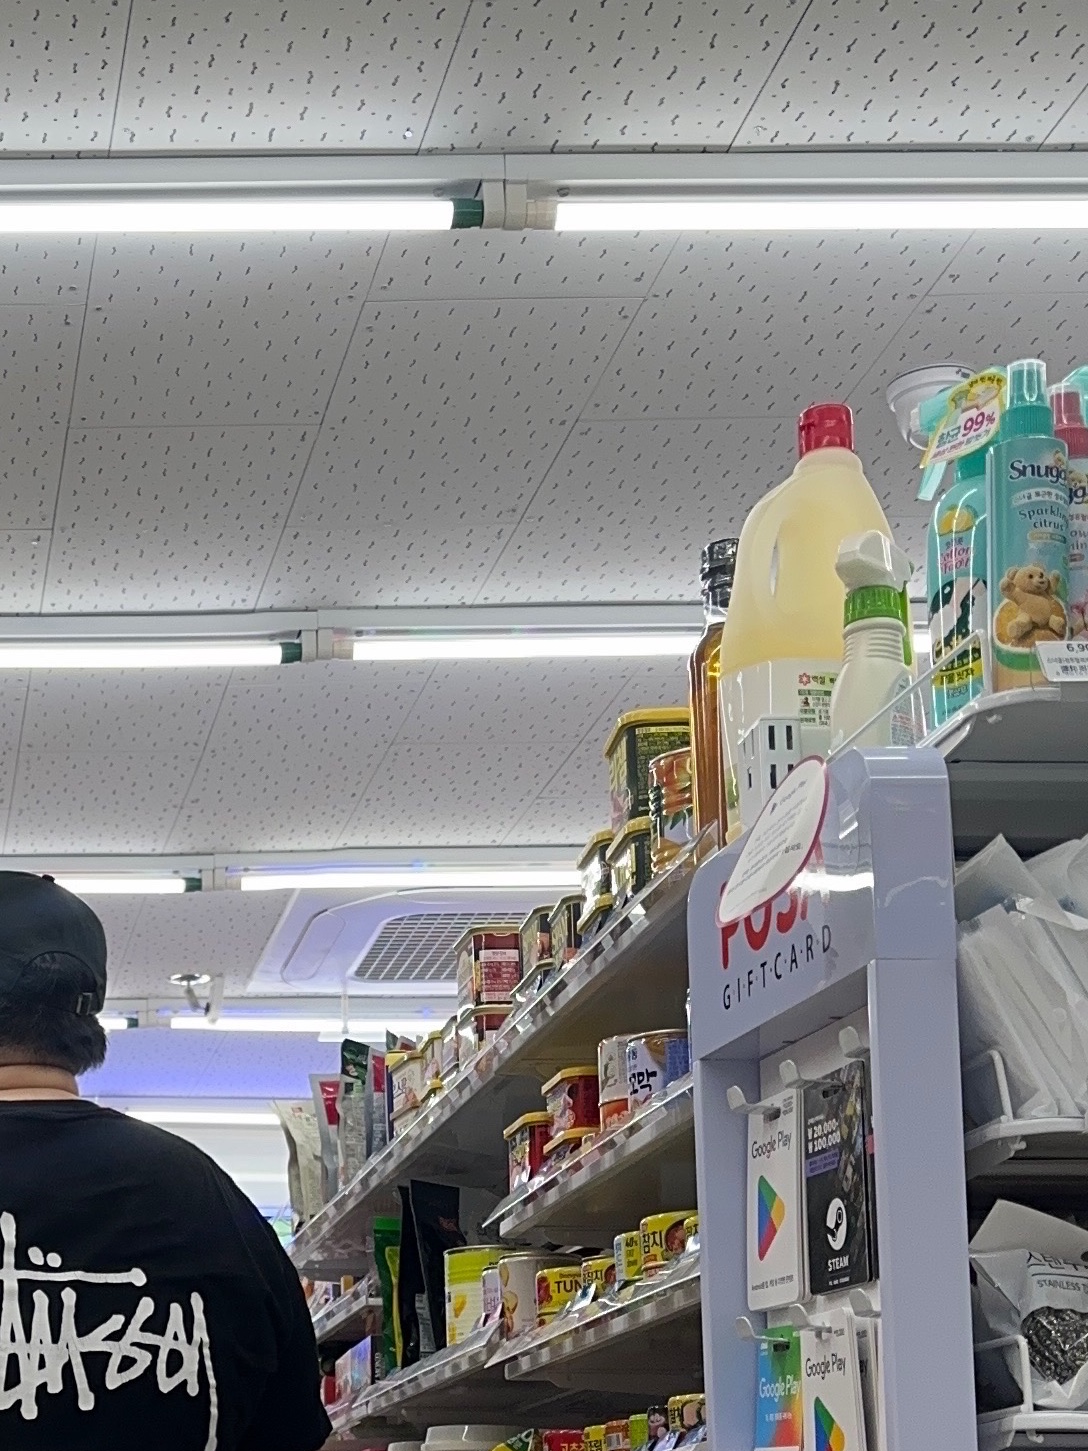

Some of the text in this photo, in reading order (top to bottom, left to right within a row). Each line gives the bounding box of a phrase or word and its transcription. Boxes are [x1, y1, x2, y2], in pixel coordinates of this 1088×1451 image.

[962, 412, 996, 437] 99%
[752, 1130, 792, 1159] Google Play
[827, 1254, 850, 1272] STEAM
[554, 1280, 584, 1294] TUN
[1037, 1279, 1080, 1291] STAINLESS
[806, 1353, 847, 1380] Google Play
[760, 1374, 801, 1402] Google Play
